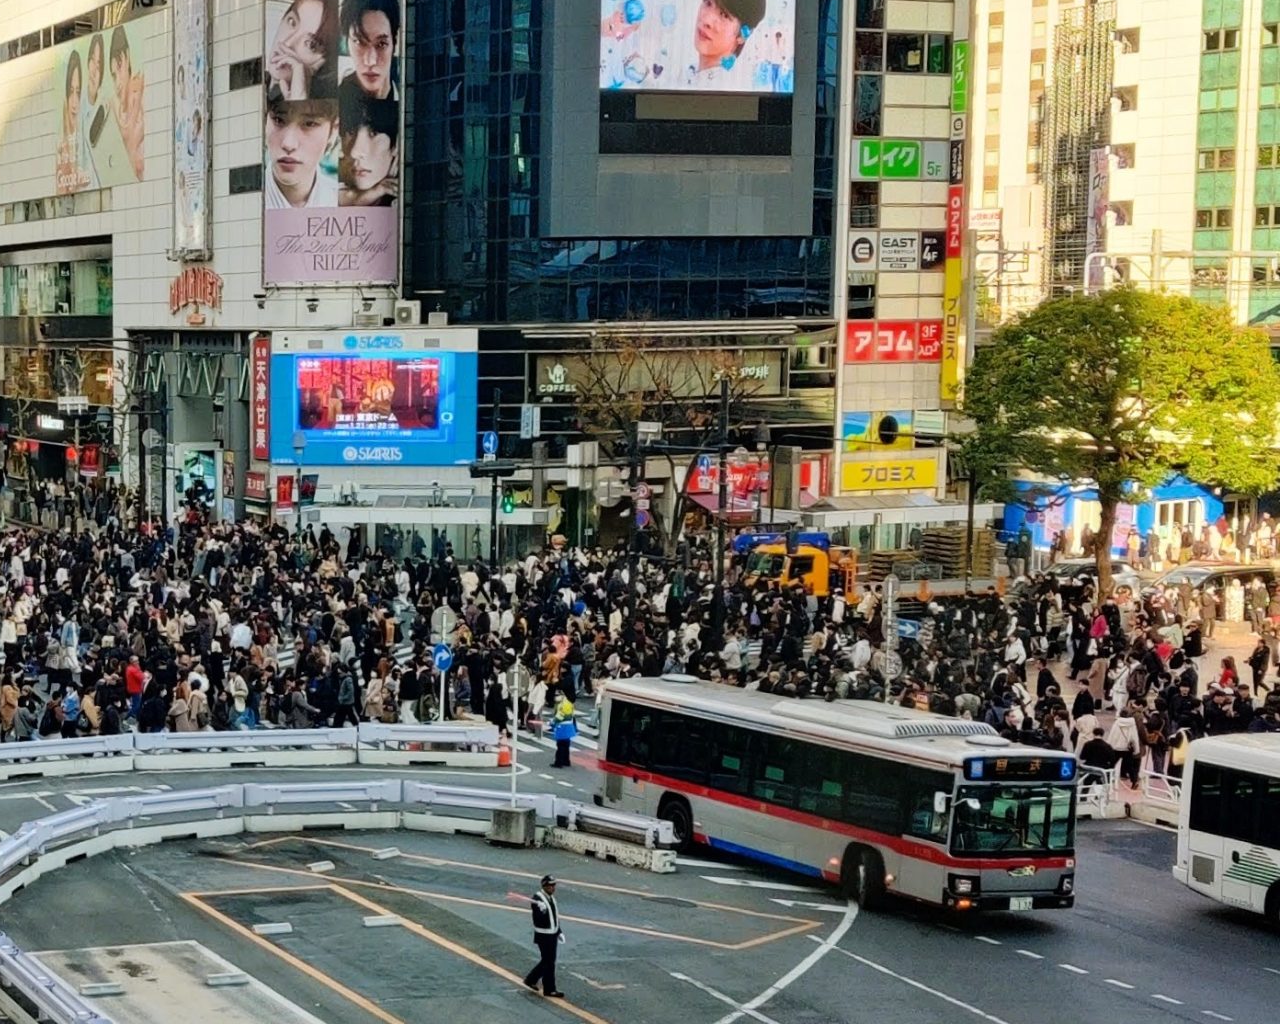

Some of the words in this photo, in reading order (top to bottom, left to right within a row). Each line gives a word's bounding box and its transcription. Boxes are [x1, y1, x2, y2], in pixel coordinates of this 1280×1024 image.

[863, 146, 917, 168] レイク
[927, 161, 943, 176] 5F
[307, 216, 367, 237] FAME
[950, 211, 960, 248] アコム
[275, 234, 307, 255] The
[881, 238, 917, 248] EAST
[922, 245, 939, 262] 4F
[313, 254, 360, 271] RIIZE
[921, 325, 938, 338] 3F
[945, 298, 958, 360] プロミス
[854, 330, 914, 353] アコム
[861, 465, 917, 484] プロミス
